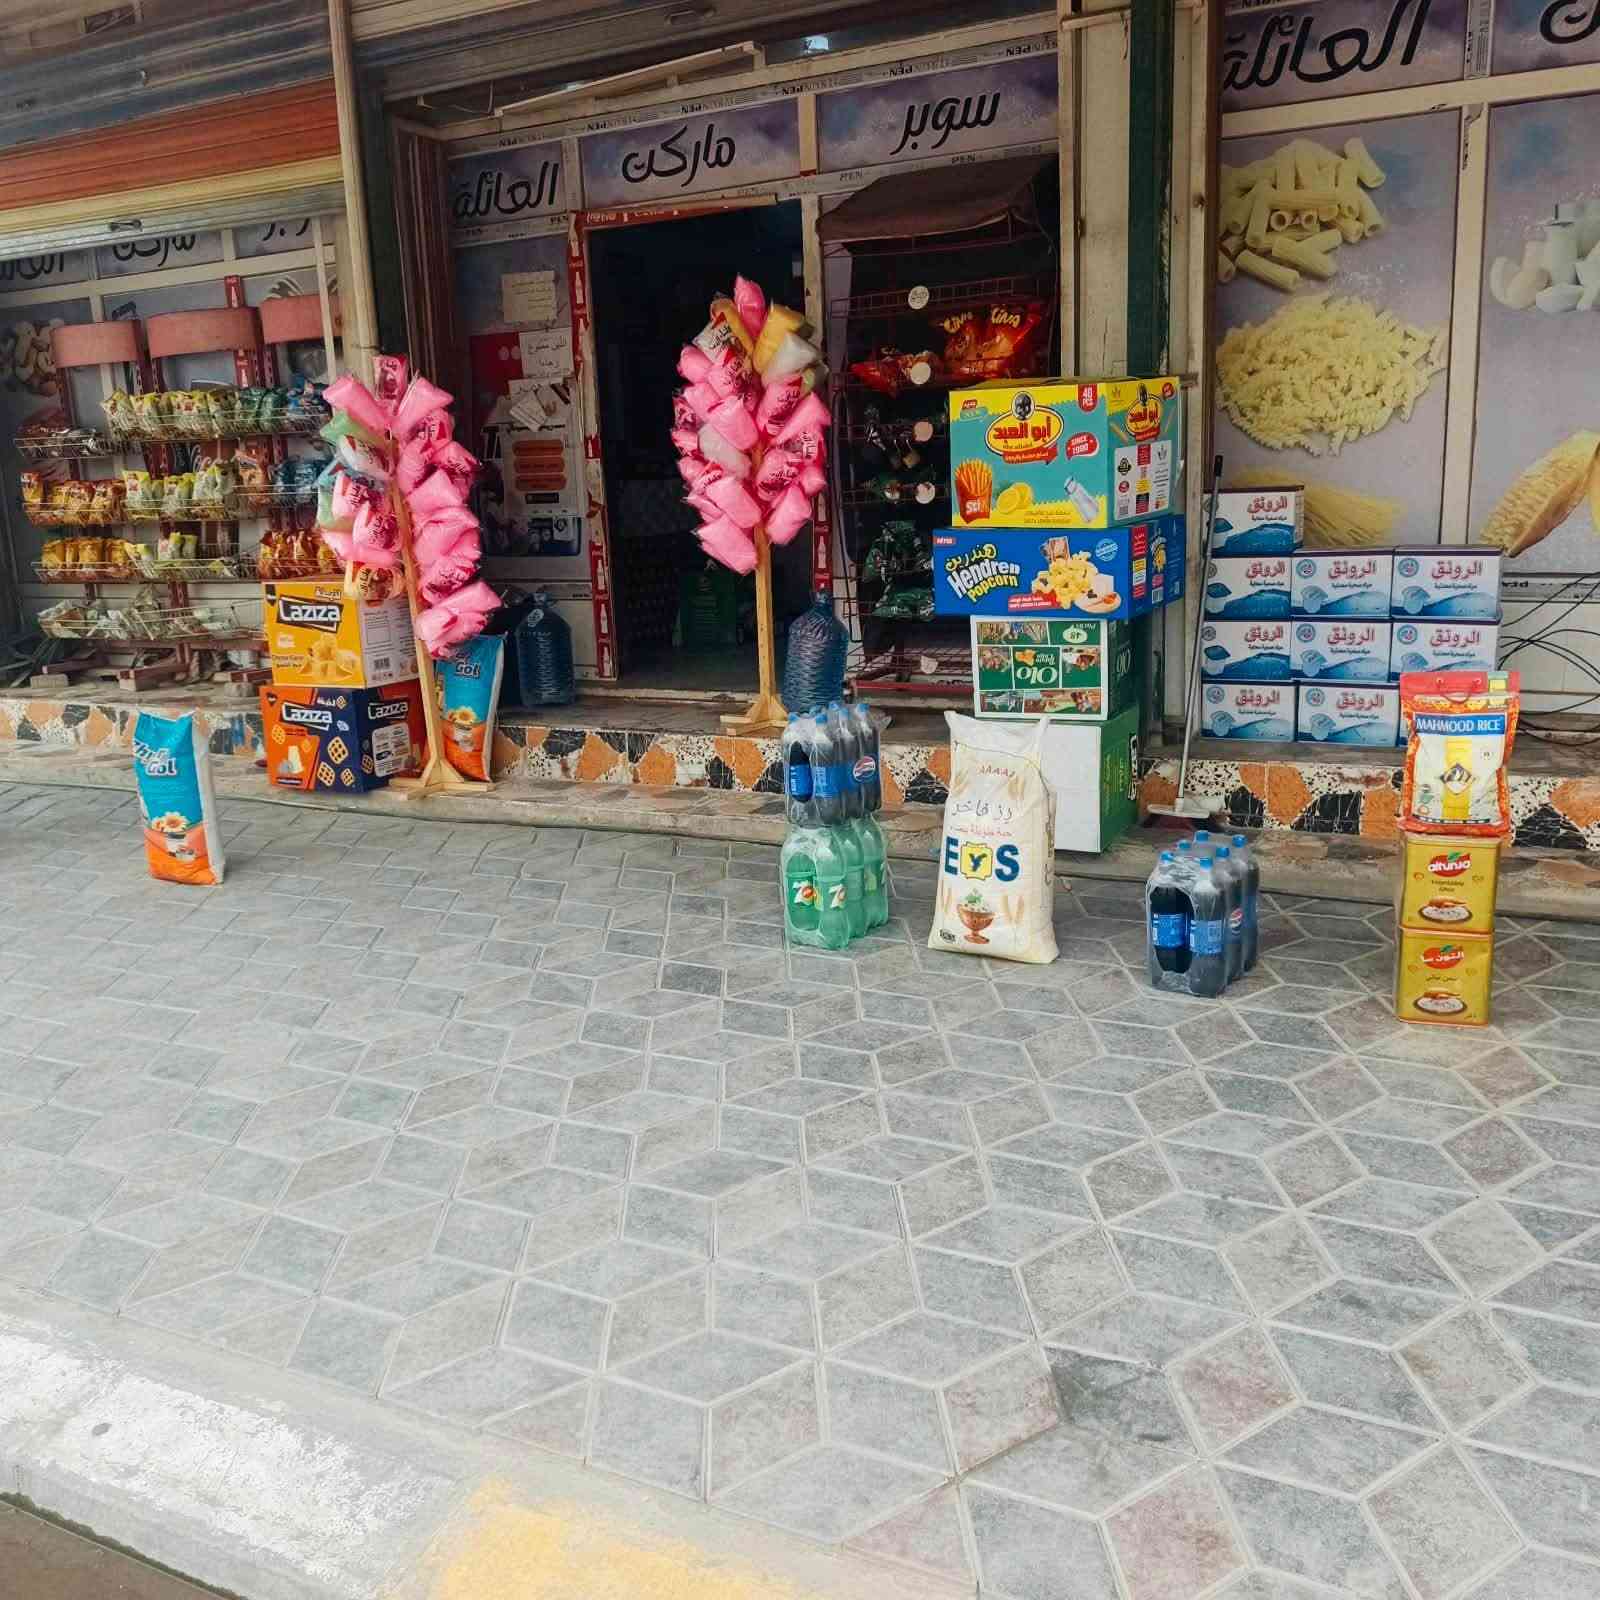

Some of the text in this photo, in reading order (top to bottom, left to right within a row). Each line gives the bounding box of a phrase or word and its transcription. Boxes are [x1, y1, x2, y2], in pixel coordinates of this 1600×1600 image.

[890, 92, 1000, 156] سوبر
[622, 124, 736, 188] ماركت
[947, 560, 1021, 599] Hendren
[967, 574, 1020, 603] Popcorn
[279, 599, 341, 624] Laziza
[281, 702, 333, 724] Laziza
[1416, 717, 1501, 733] MAHMOOD RICE
